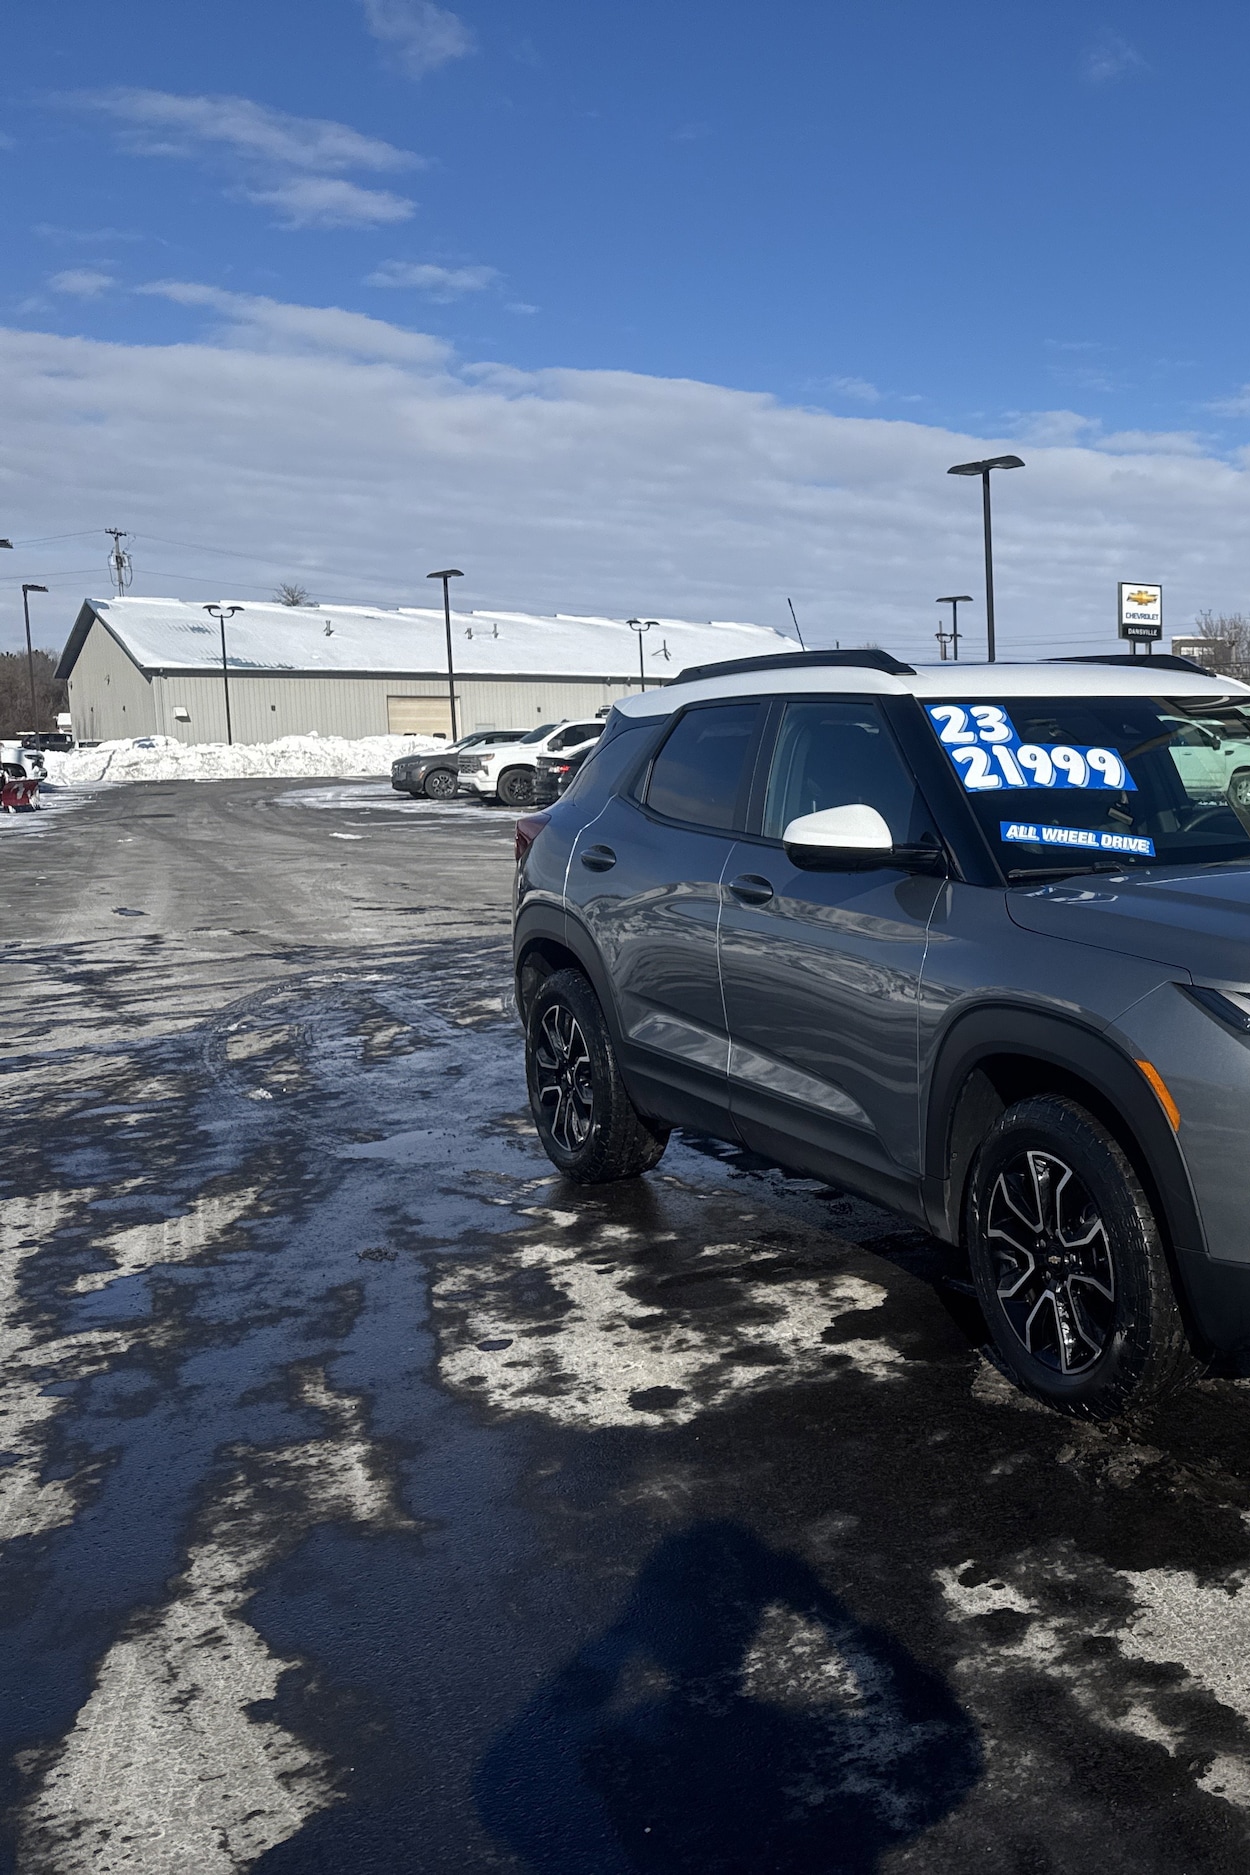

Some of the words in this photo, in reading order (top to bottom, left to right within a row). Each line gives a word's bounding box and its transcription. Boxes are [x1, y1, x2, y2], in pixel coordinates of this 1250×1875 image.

[1125, 612, 1159, 620] CHEVROLET
[1127, 627, 1158, 636] DANSVILLE
[930, 705, 1013, 744] 23
[951, 744, 1126, 789] 21999
[1005, 824, 1039, 841] ALL
[1041, 827, 1099, 847] WHEEL
[1100, 834, 1150, 854] DRIVE
